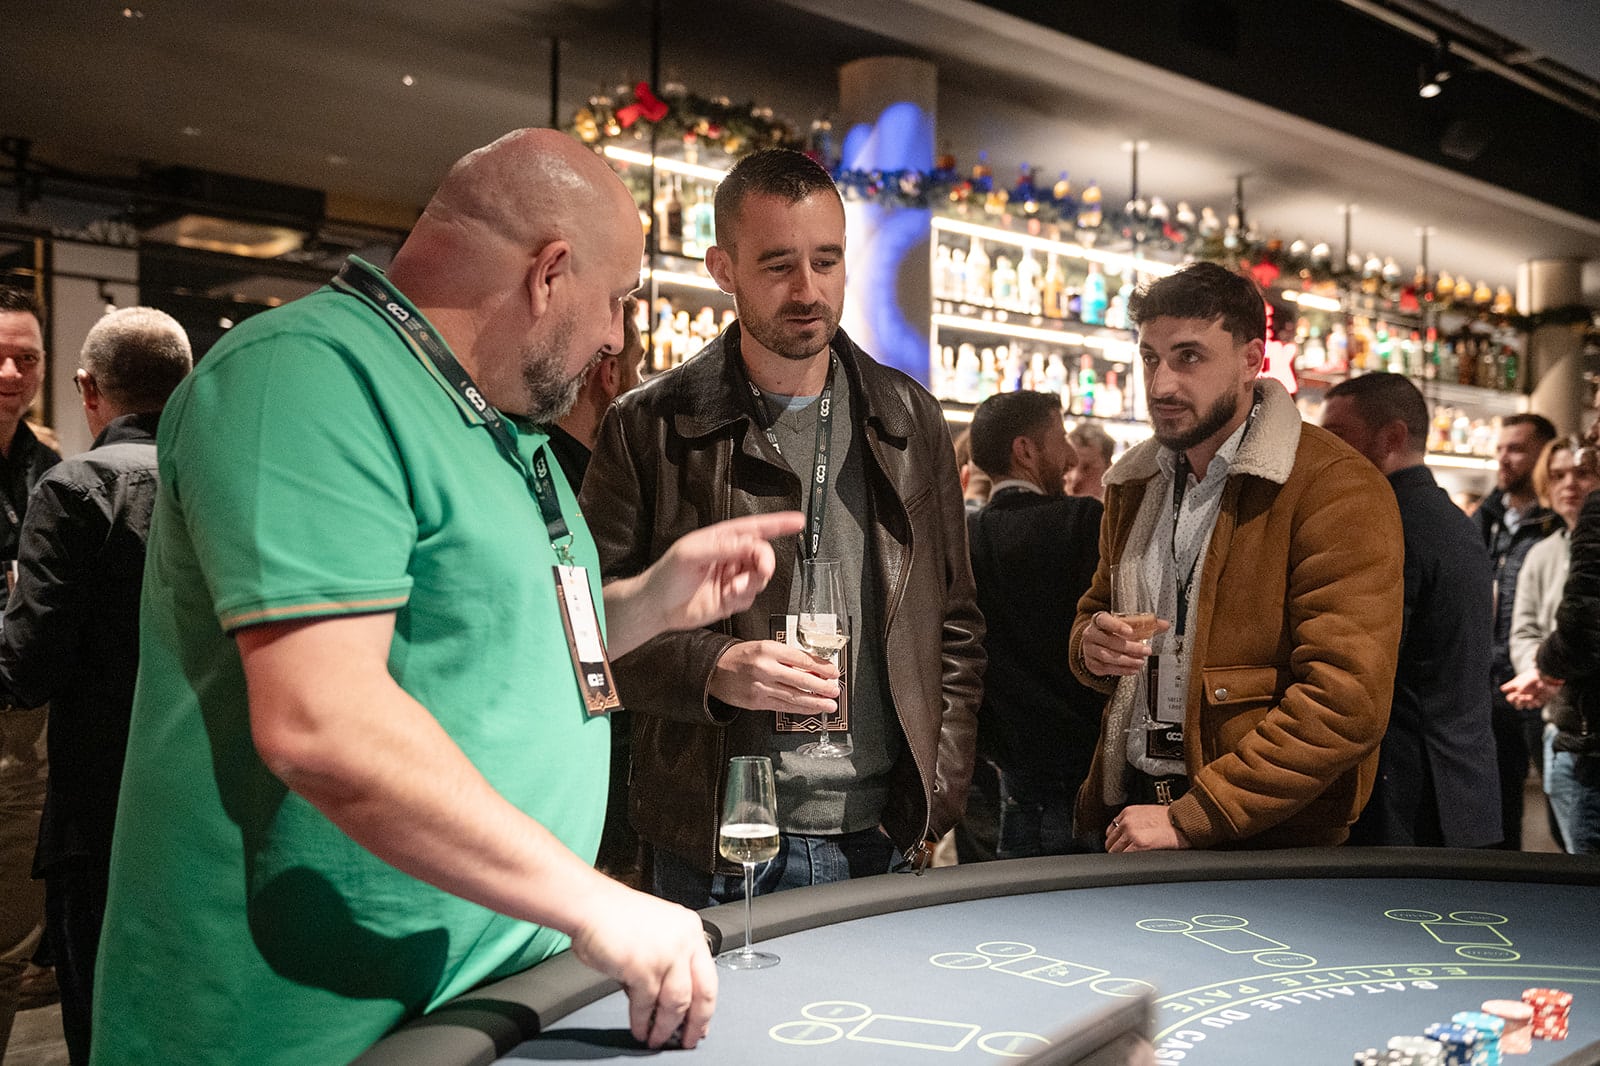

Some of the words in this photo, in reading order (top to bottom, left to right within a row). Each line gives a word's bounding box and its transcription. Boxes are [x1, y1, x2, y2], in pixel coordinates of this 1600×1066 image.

[1272, 967, 1468, 988] EGALITE
[1161, 984, 1260, 1013] PAYE
[1250, 980, 1439, 1011] BATAILLE
[1200, 1009, 1251, 1029] DU
